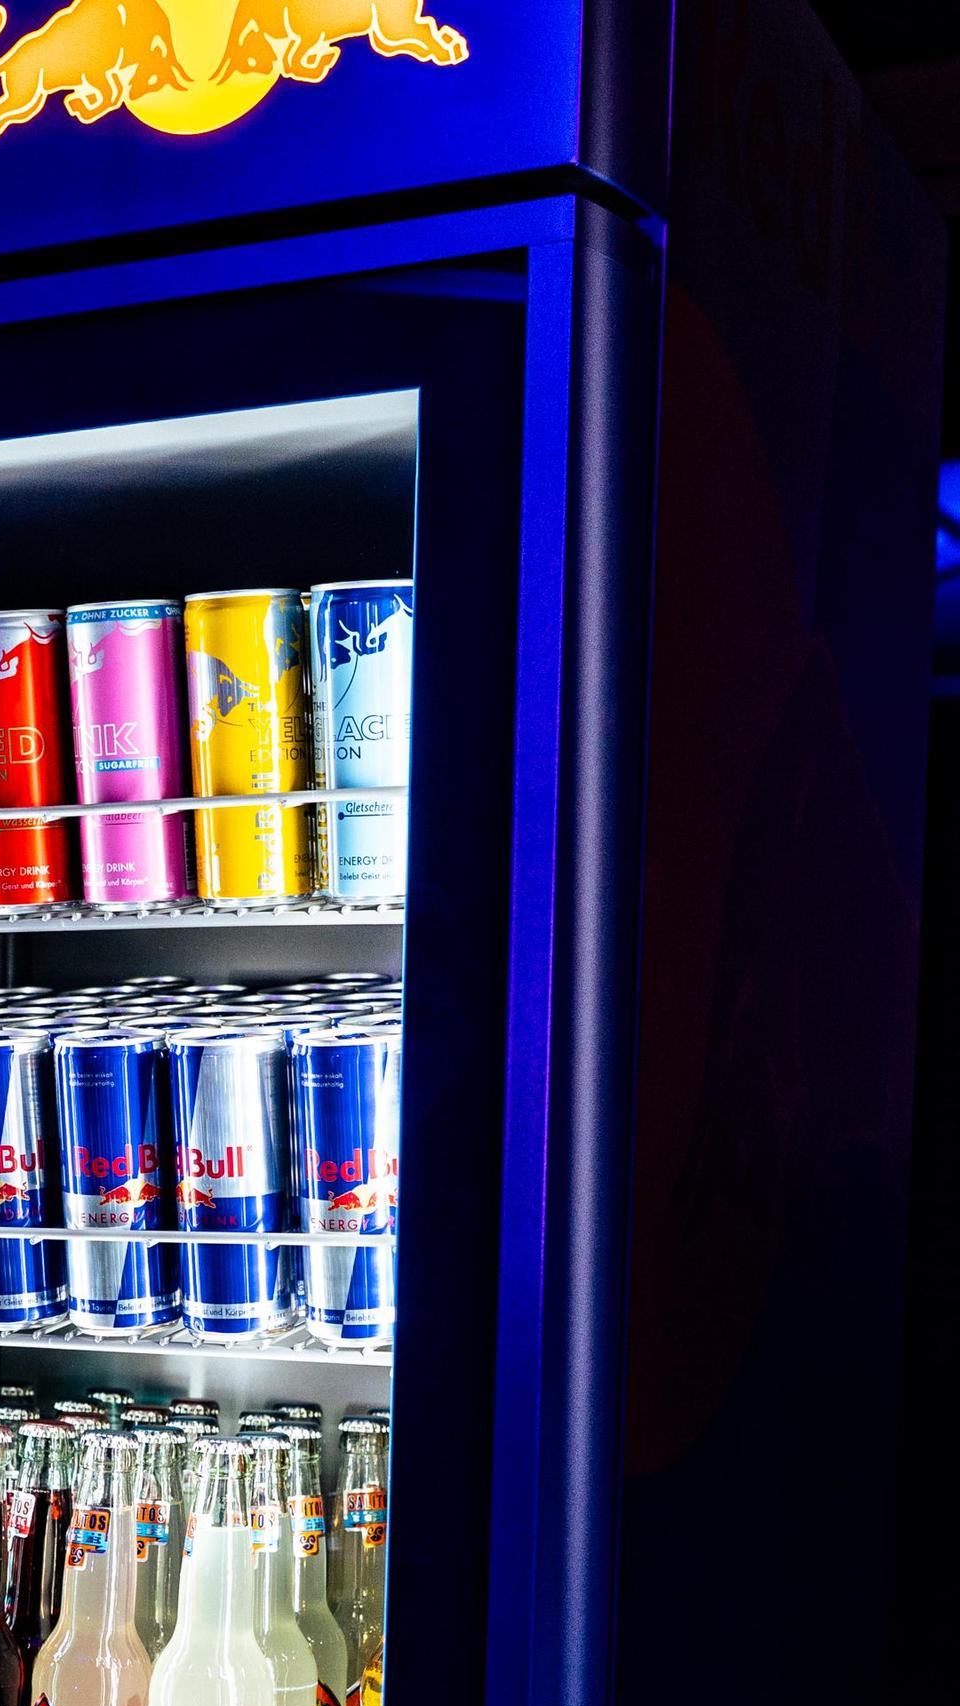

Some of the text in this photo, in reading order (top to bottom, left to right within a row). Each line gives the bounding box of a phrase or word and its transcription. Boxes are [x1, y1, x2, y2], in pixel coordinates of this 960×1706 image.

[81, 609, 149, 621] OHNE ZUCKER
[20, 866, 50, 877] DRINK
[106, 862, 136, 873] DRINK
[20, 882, 34, 890] und
[73, 1144, 132, 1177] Red
[188, 1146, 244, 1179] Bull
[304, 1147, 363, 1182] Red
[81, 1212, 139, 1225] ENERGY
[311, 1218, 369, 1232] ENERGY
